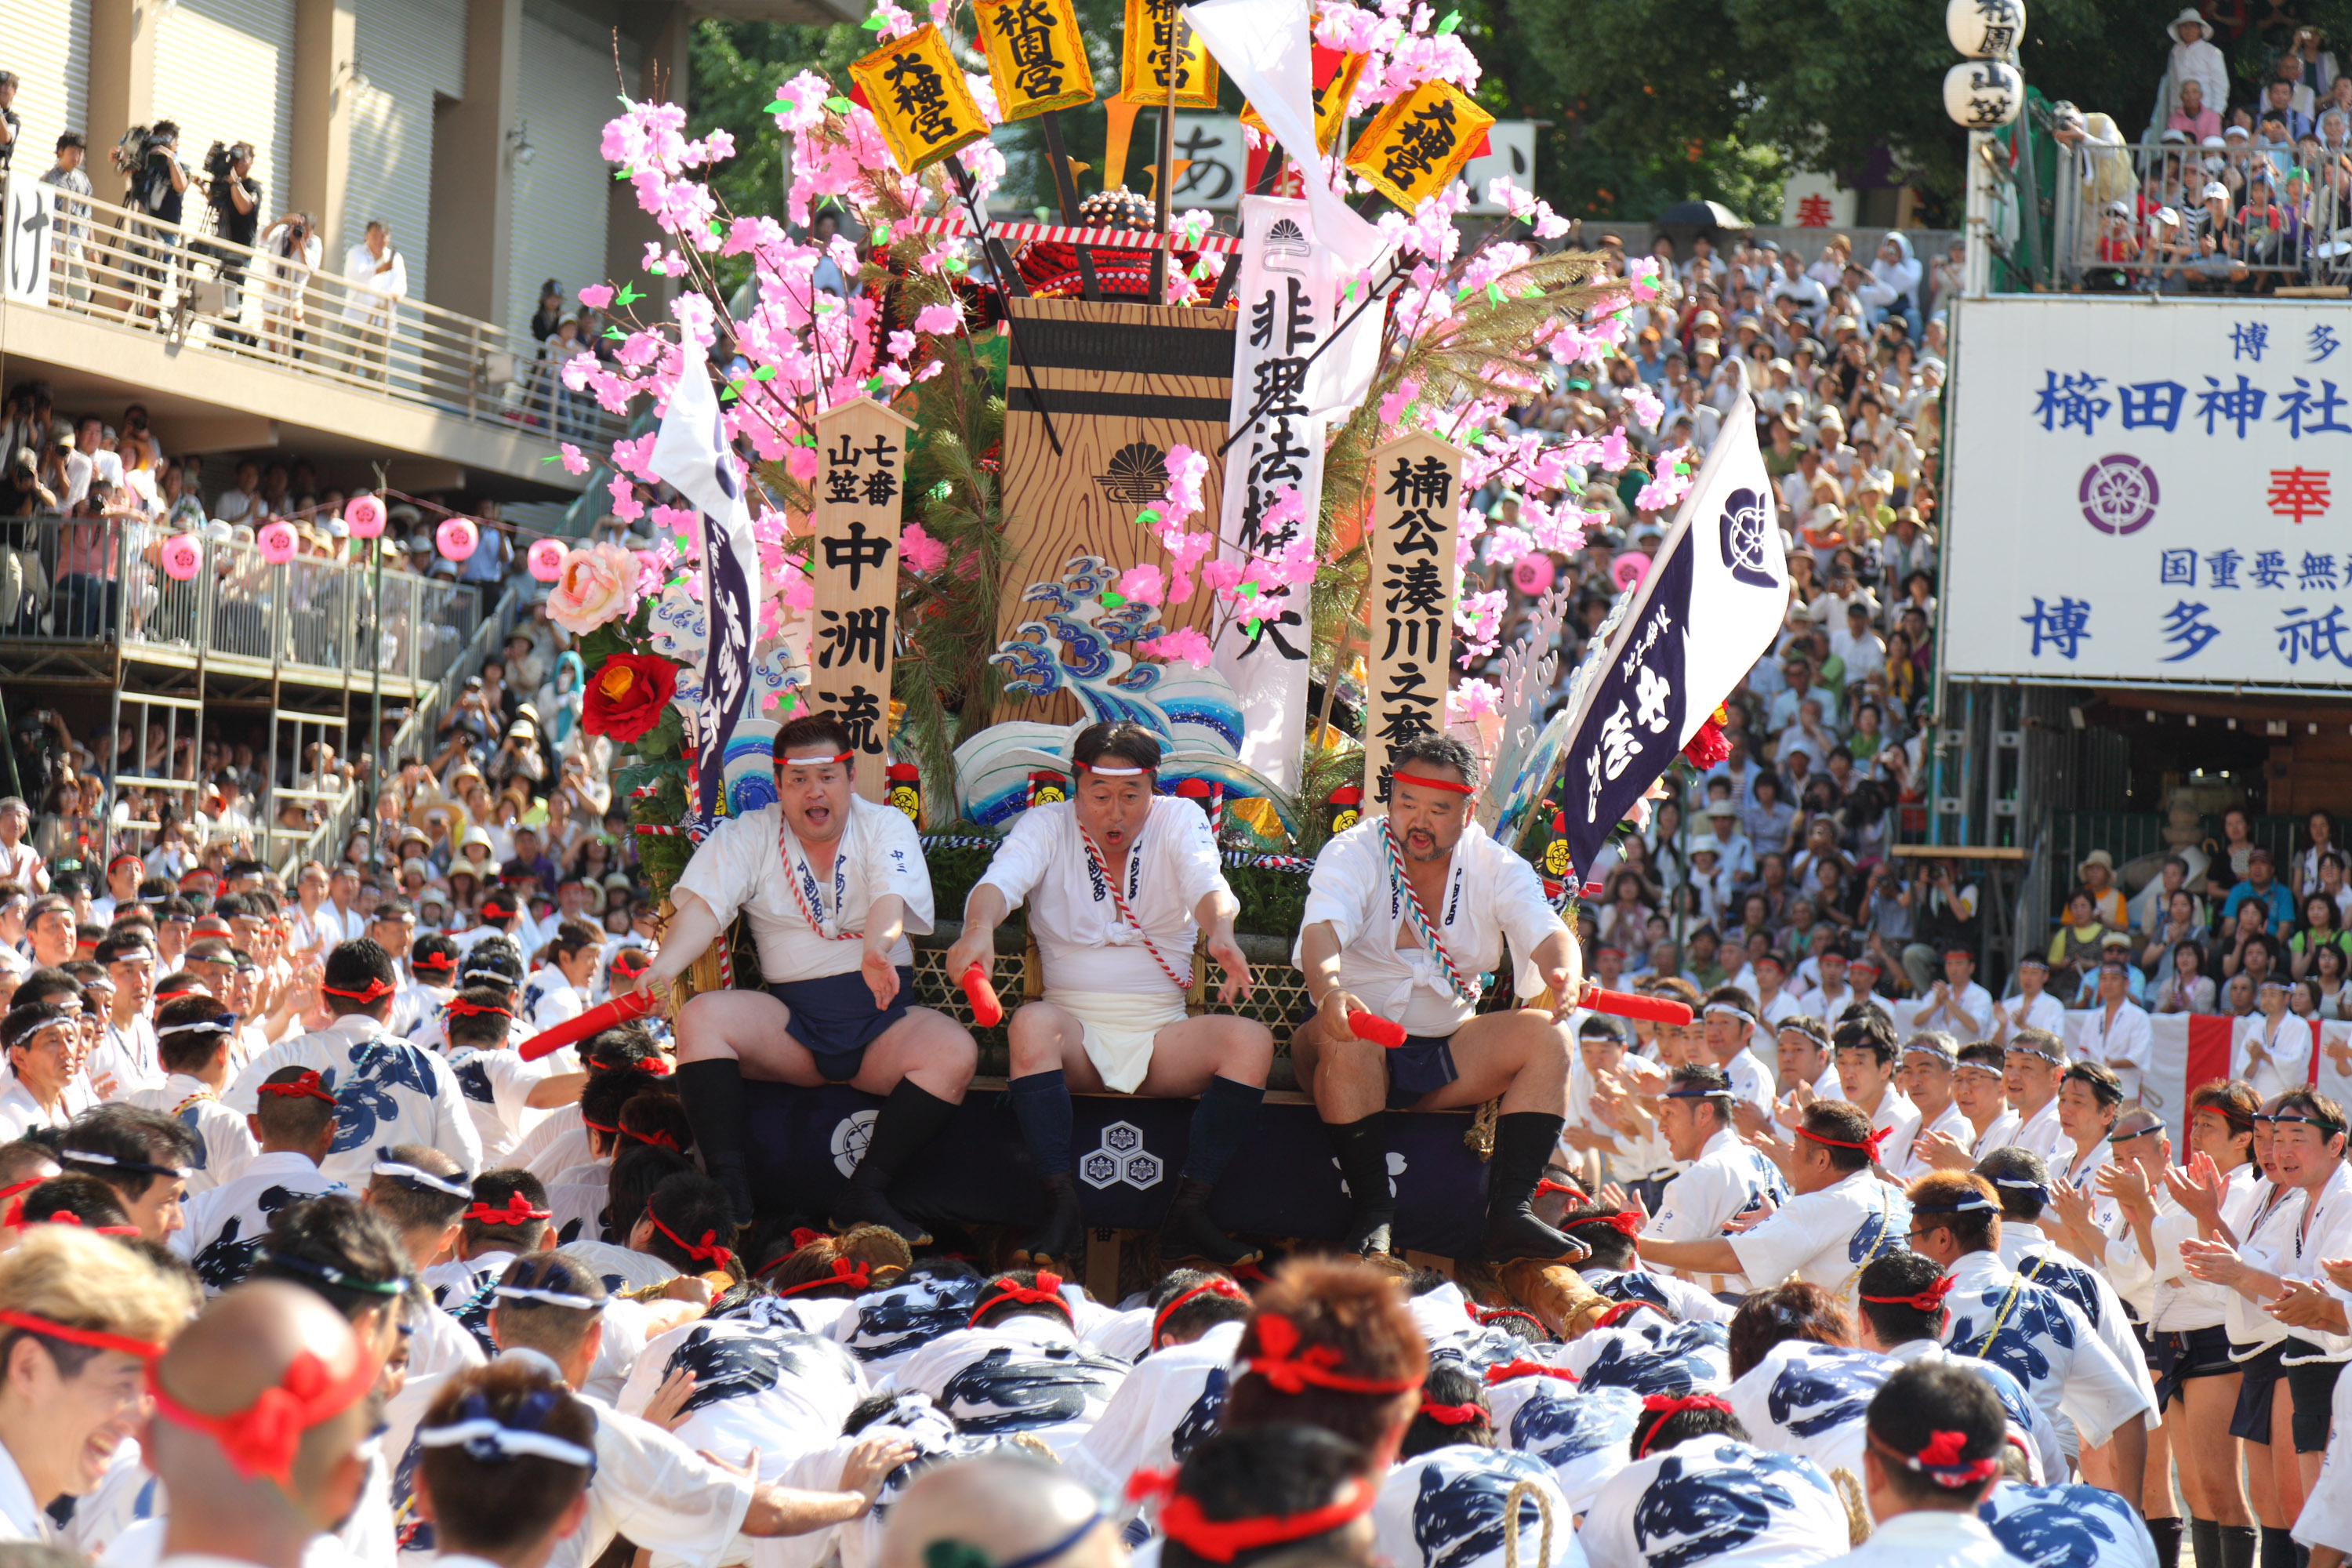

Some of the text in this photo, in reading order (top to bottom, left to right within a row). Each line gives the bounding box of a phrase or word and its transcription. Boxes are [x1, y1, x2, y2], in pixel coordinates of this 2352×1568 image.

[2032, 370, 2352, 439] 櫛田神社
[2267, 465, 2332, 524] 奉
[2160, 548, 2352, 590] 国重要無
[818, 521, 893, 755] 中洲流
